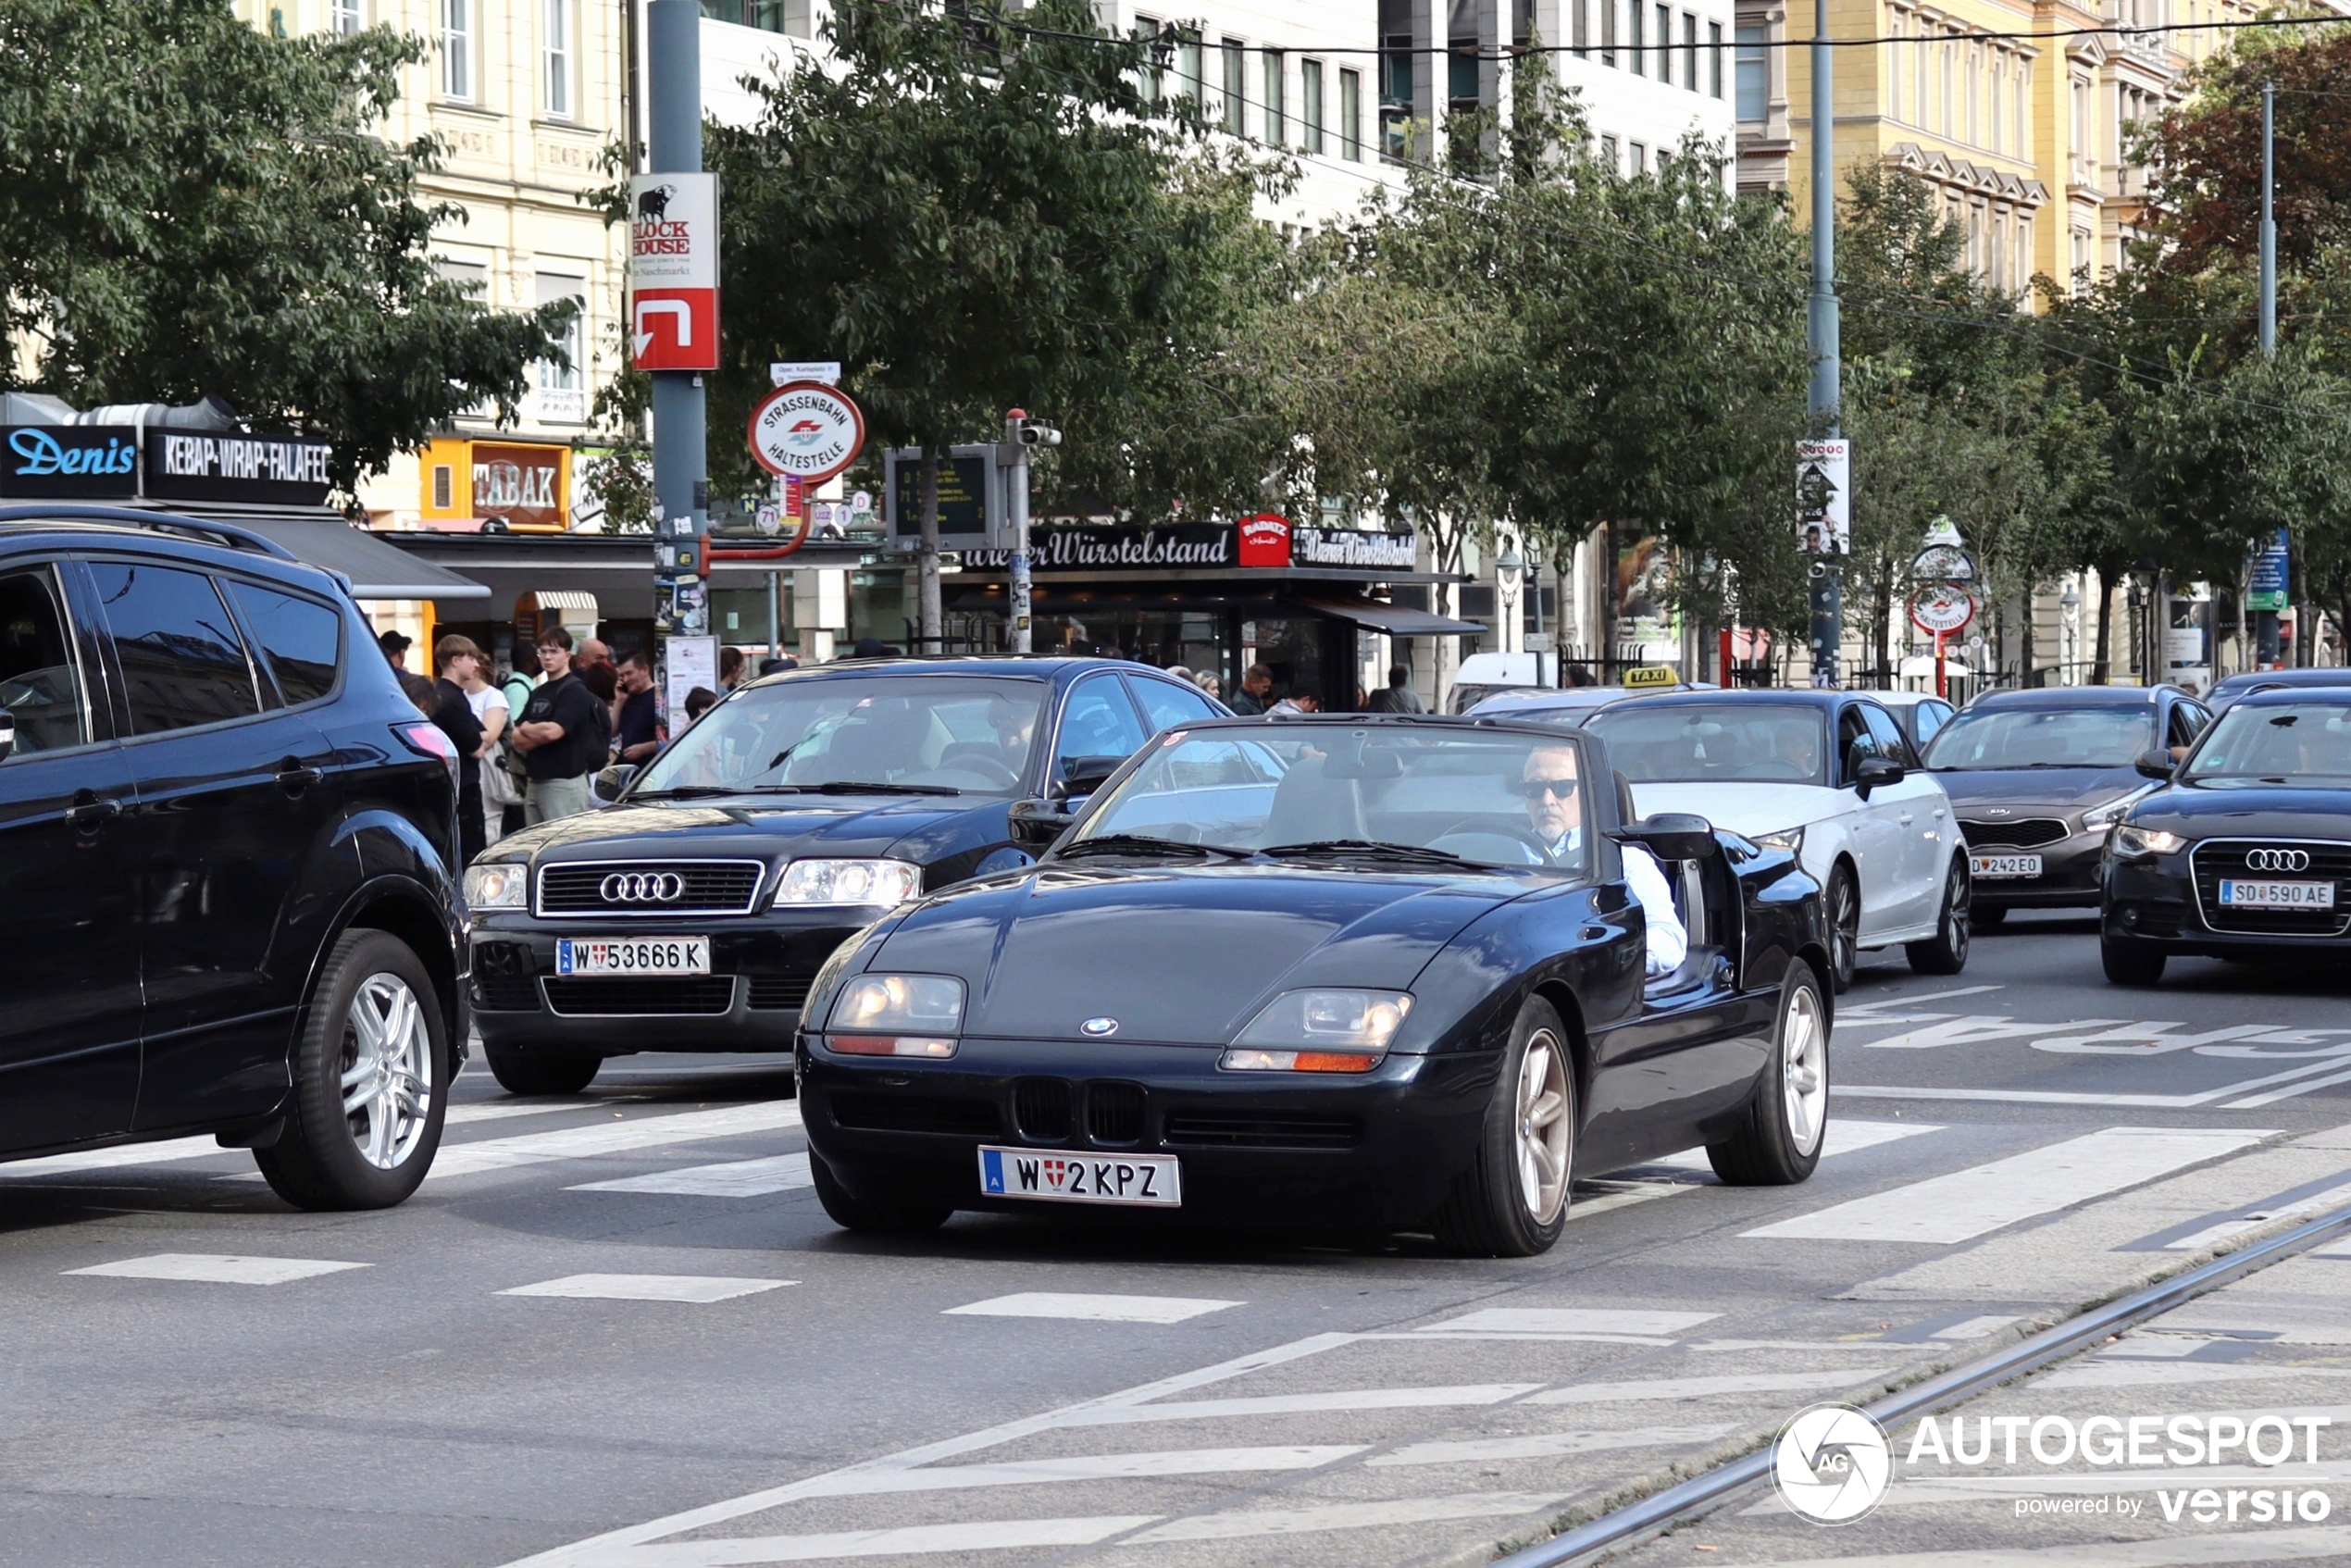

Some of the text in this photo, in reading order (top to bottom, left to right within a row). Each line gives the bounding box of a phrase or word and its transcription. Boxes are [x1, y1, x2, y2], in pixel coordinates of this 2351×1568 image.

[765, 396, 848, 429] STRASSENBAHN
[9, 428, 135, 475] Denis
[768, 441, 844, 468] HALTESTELLE
[473, 463, 556, 508] TABAK
[744, 500, 755, 513] N
[857, 496, 865, 508] D
[762, 511, 775, 523] 71
[841, 511, 846, 521] 1
[1242, 520, 1287, 537] RADATZ
[965, 530, 1228, 566] Wieer Würstelstand
[1920, 613, 1964, 628] HALTESTELLE
[1634, 670, 1664, 681] TAXI
[1972, 859, 1980, 872] D
[1990, 859, 2016, 872] 242
[2235, 885, 2257, 902] SD
[2270, 885, 2301, 902] 590
[2306, 887, 2327, 903] AE
[574, 944, 590, 969] W
[607, 944, 679, 968] 53666
[687, 943, 700, 968] K
[990, 1177, 1000, 1187] A
[1016, 1158, 1039, 1191] W
